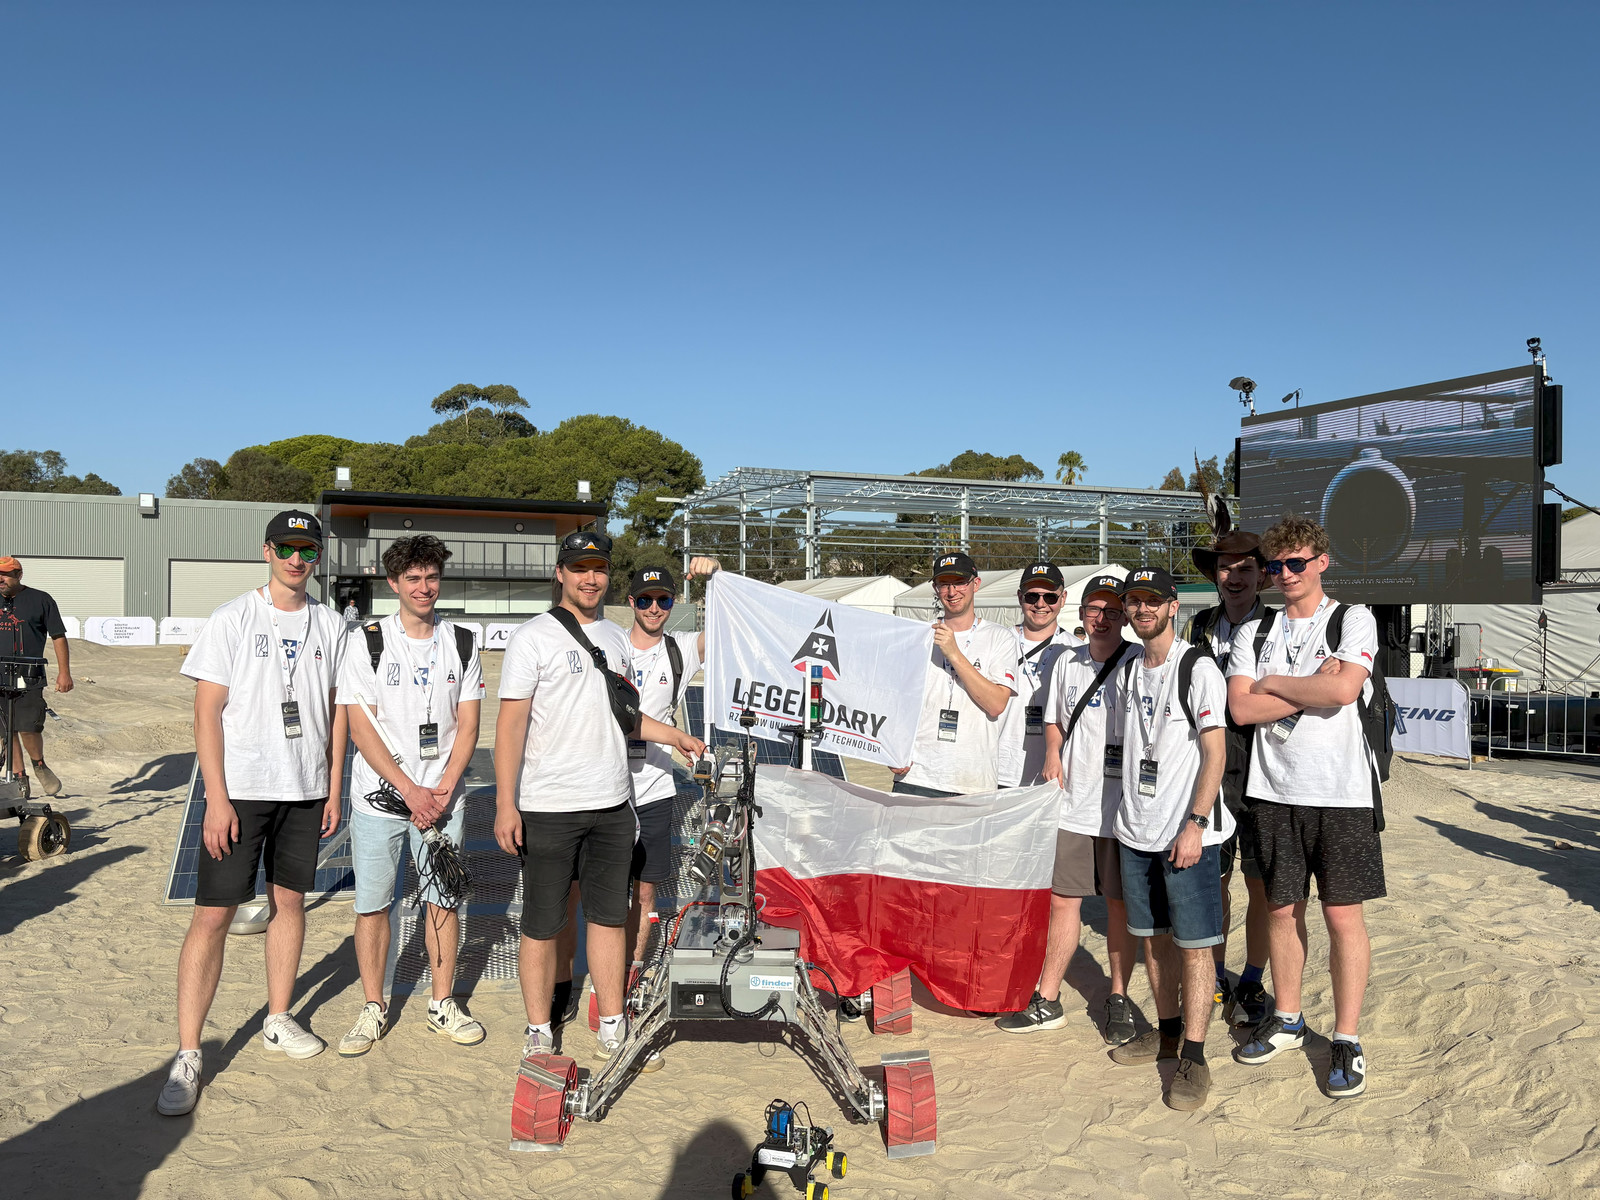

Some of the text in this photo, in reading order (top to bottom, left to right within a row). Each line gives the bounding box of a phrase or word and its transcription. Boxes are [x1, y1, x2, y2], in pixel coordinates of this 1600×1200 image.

[288, 518, 310, 529] CAT
[940, 557, 958, 567] CAT
[1032, 566, 1049, 574] CAT
[643, 571, 661, 581] CAT
[1134, 571, 1156, 581] CAT
[1099, 578, 1119, 588] CAT
[1398, 706, 1456, 721] EING
[831, 734, 881, 754] TECHNOLOGY
[761, 979, 792, 987] finder
